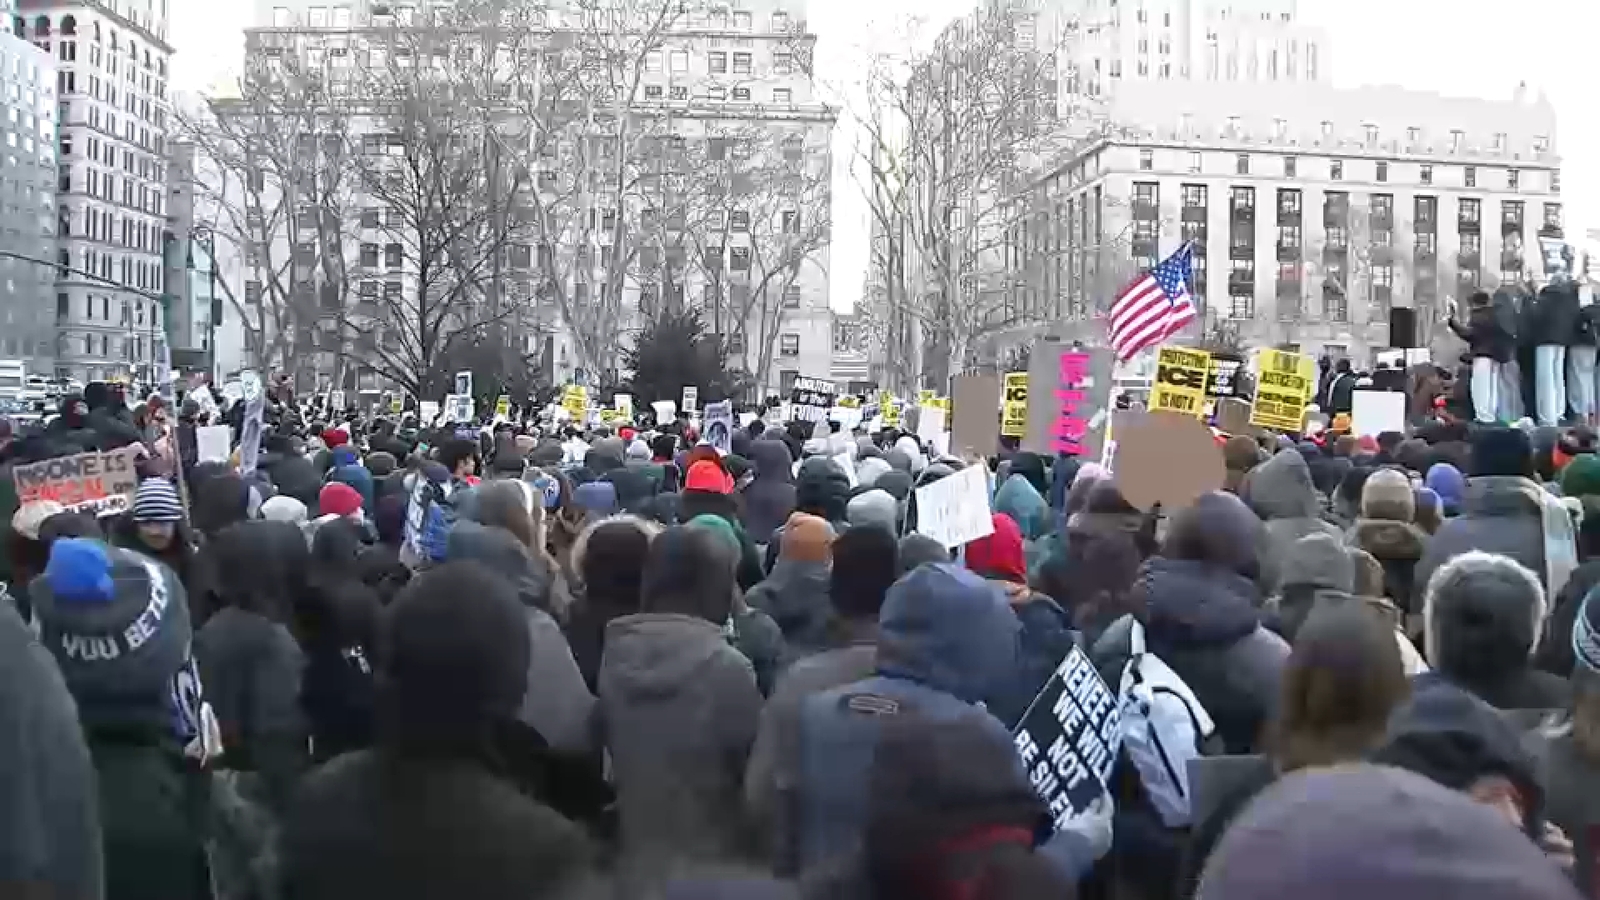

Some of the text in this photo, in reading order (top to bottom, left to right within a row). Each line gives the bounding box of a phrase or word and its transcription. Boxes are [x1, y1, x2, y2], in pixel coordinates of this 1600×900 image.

[1157, 365, 1204, 389] ICE
[1171, 392, 1187, 410] NOT
[104, 454, 126, 472] IS
[62, 631, 121, 661] YOU
[1056, 649, 1112, 727] RENEE
[1052, 689, 1115, 779] WE WILL
[1013, 728, 1074, 828] BE SILEN
[1047, 733, 1089, 790] NOT
